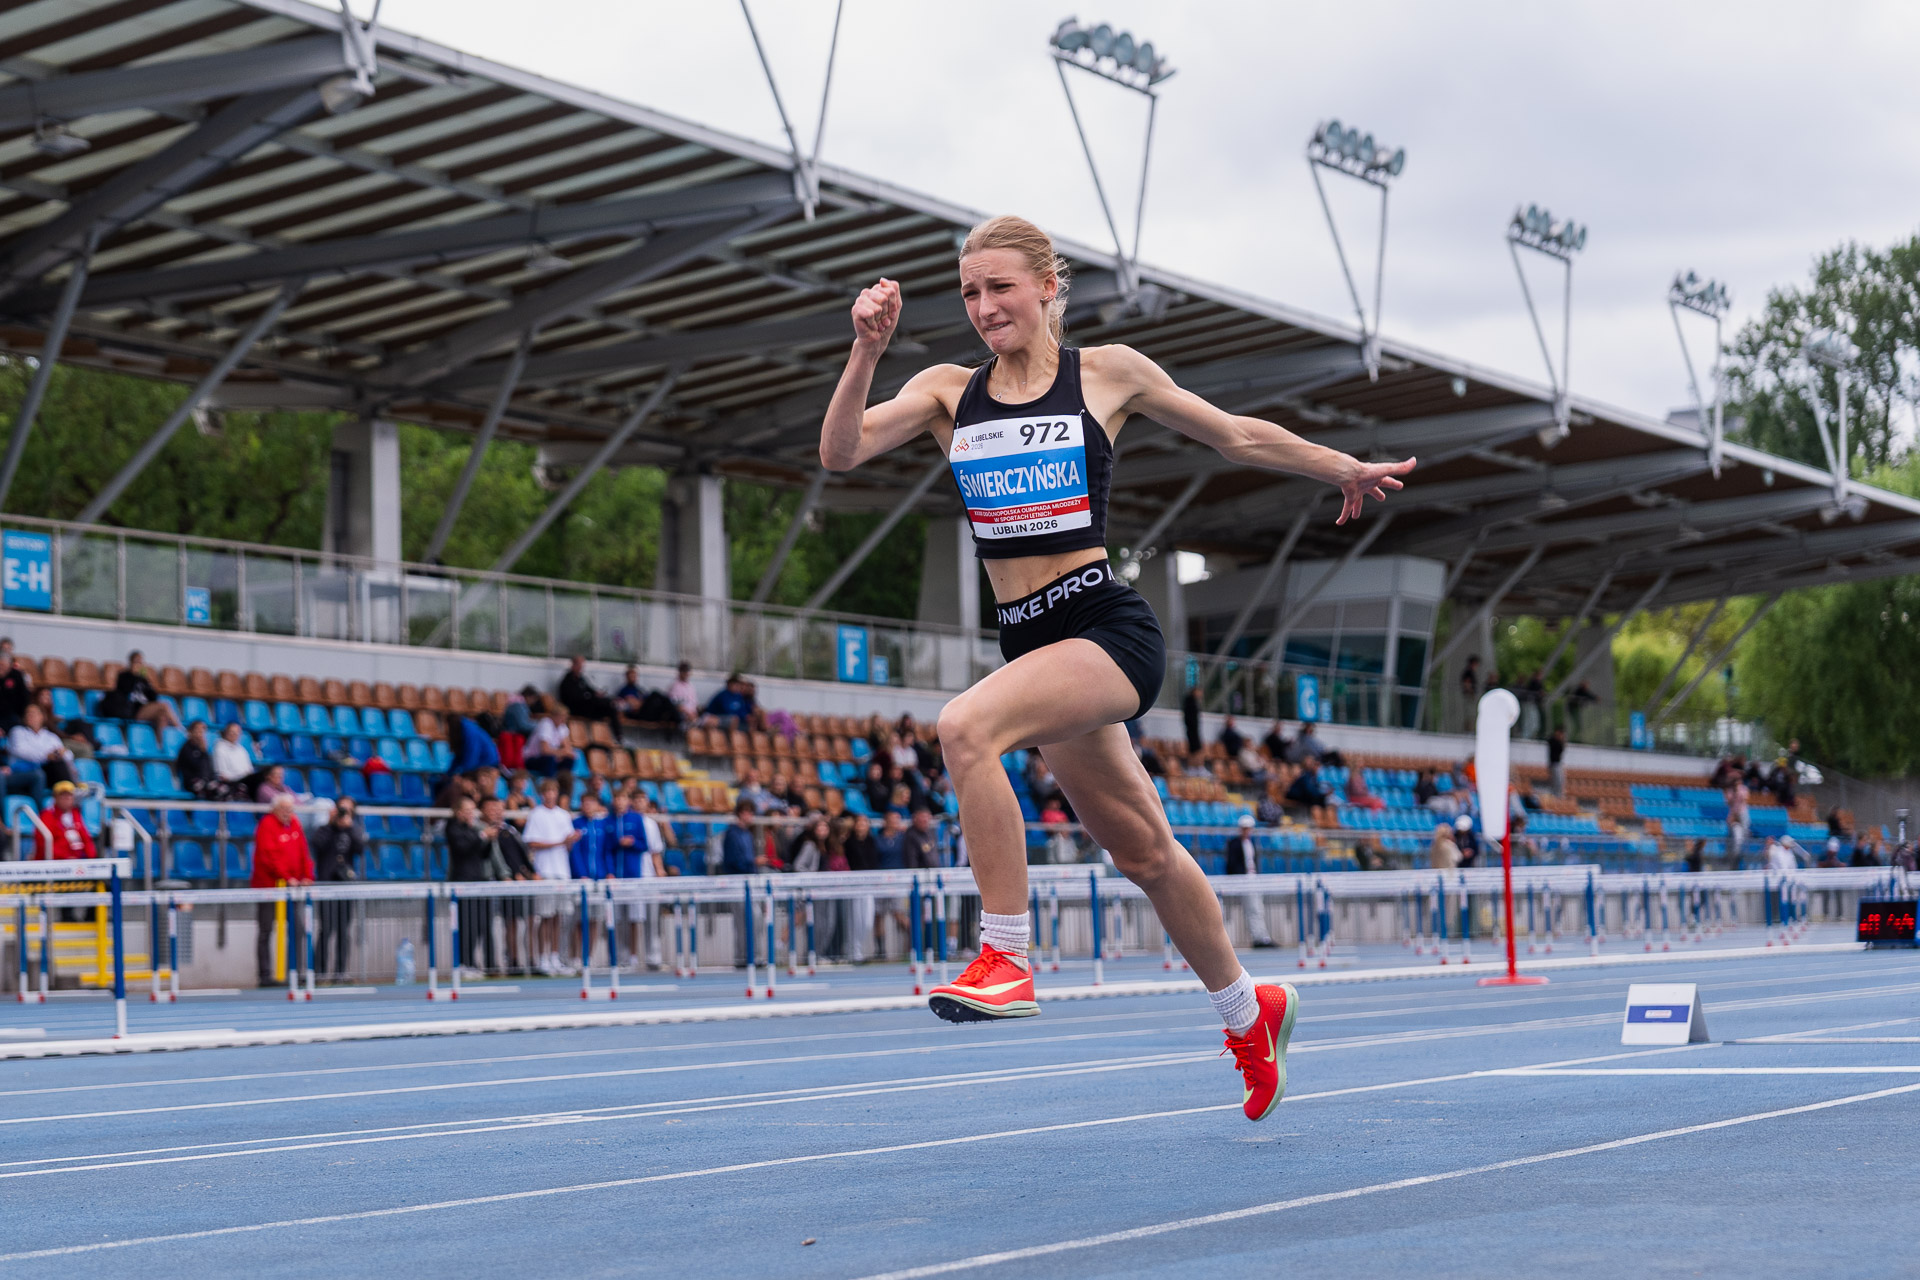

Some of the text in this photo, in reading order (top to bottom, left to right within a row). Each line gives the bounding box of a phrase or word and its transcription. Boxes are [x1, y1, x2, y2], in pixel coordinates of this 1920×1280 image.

[971, 431, 1004, 443] LUBELSKIE
[1020, 421, 1070, 446] 972
[960, 459, 1080, 498] ŚWIERCZYŃSKA
[1000, 514, 1029, 522] SPORTACH
[1029, 511, 1053, 519] LETNICH
[1021, 505, 1051, 514] OLIMPIADA
[1052, 499, 1082, 509] MŁODZIEŻY
[992, 519, 1058, 535] LUBLIN 2026
[4, 557, 50, 593] E-H
[1002, 595, 1044, 625] NIKE
[1046, 568, 1103, 609] PRO
[846, 641, 861, 678] F
